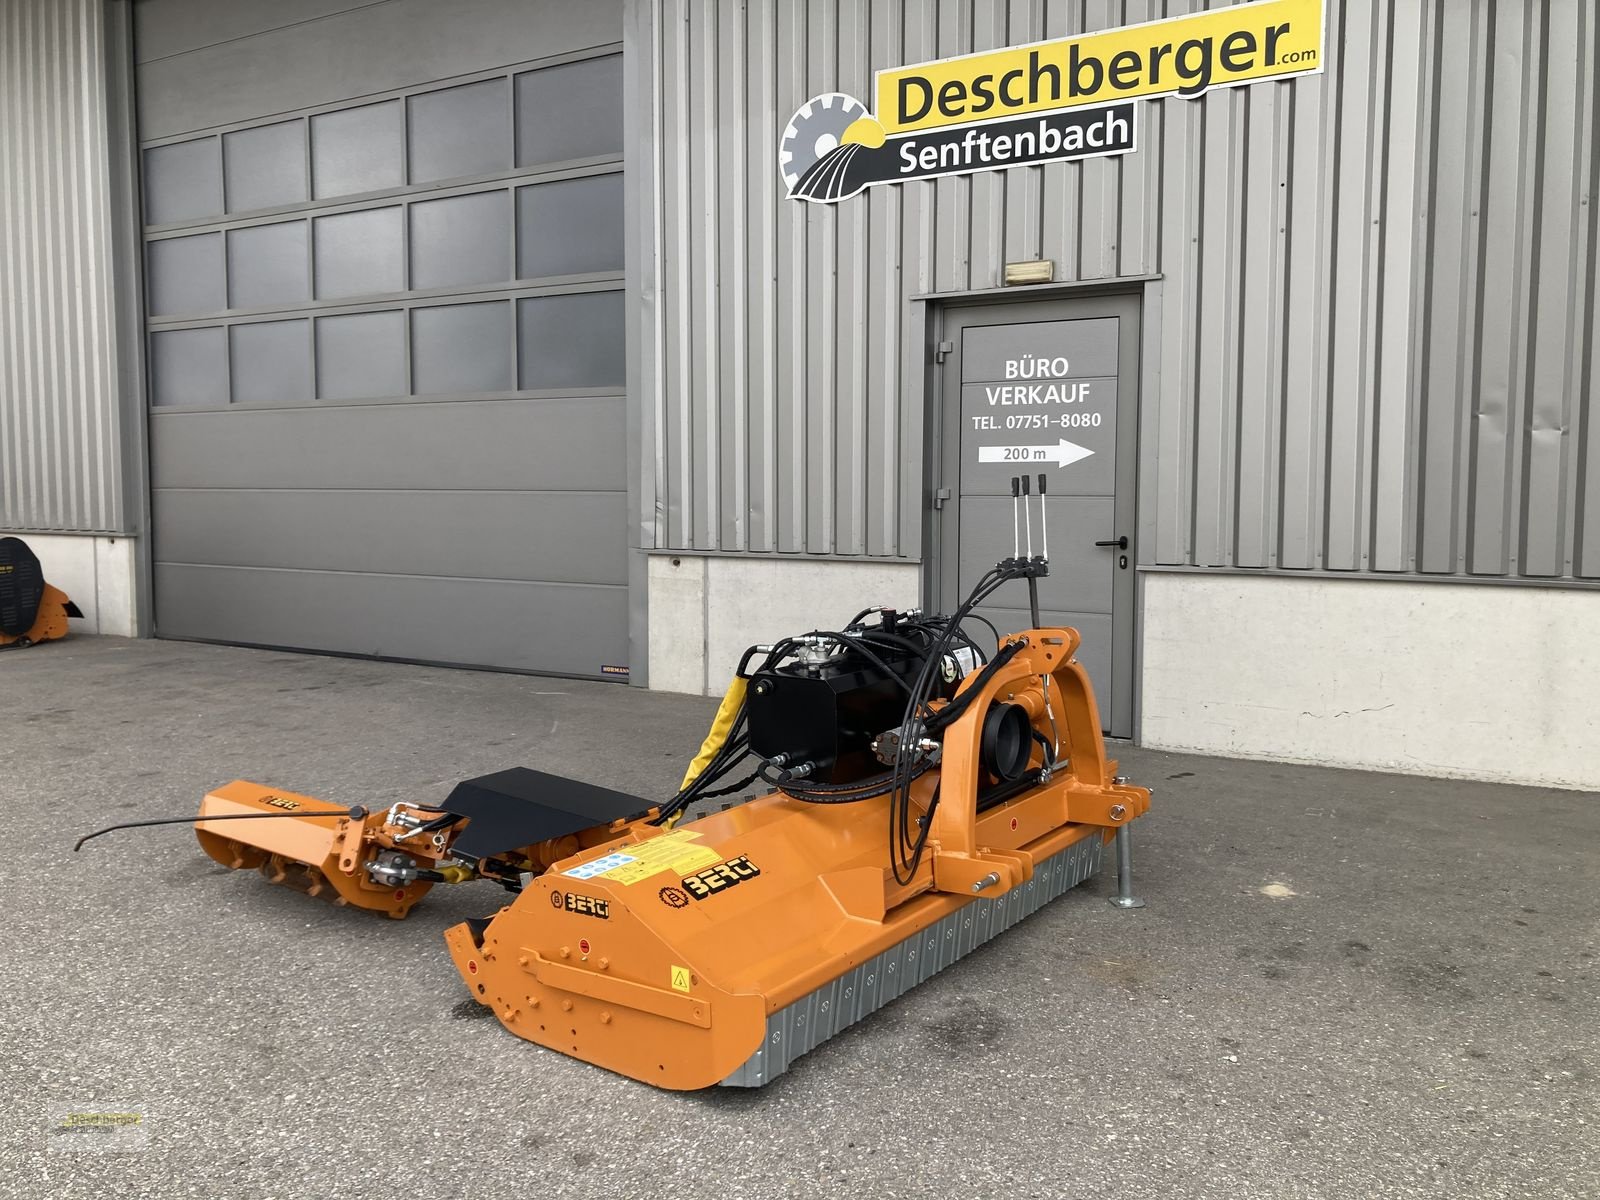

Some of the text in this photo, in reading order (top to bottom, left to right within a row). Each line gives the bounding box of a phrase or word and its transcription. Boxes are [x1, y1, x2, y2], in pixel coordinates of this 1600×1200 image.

[900, 110, 1128, 173] Senftenbach
[1005, 354, 1069, 379] BÜRO
[985, 383, 1090, 405] VERKAUF
[972, 416, 1001, 430] TEL.
[1004, 448, 1046, 460] 200 m
